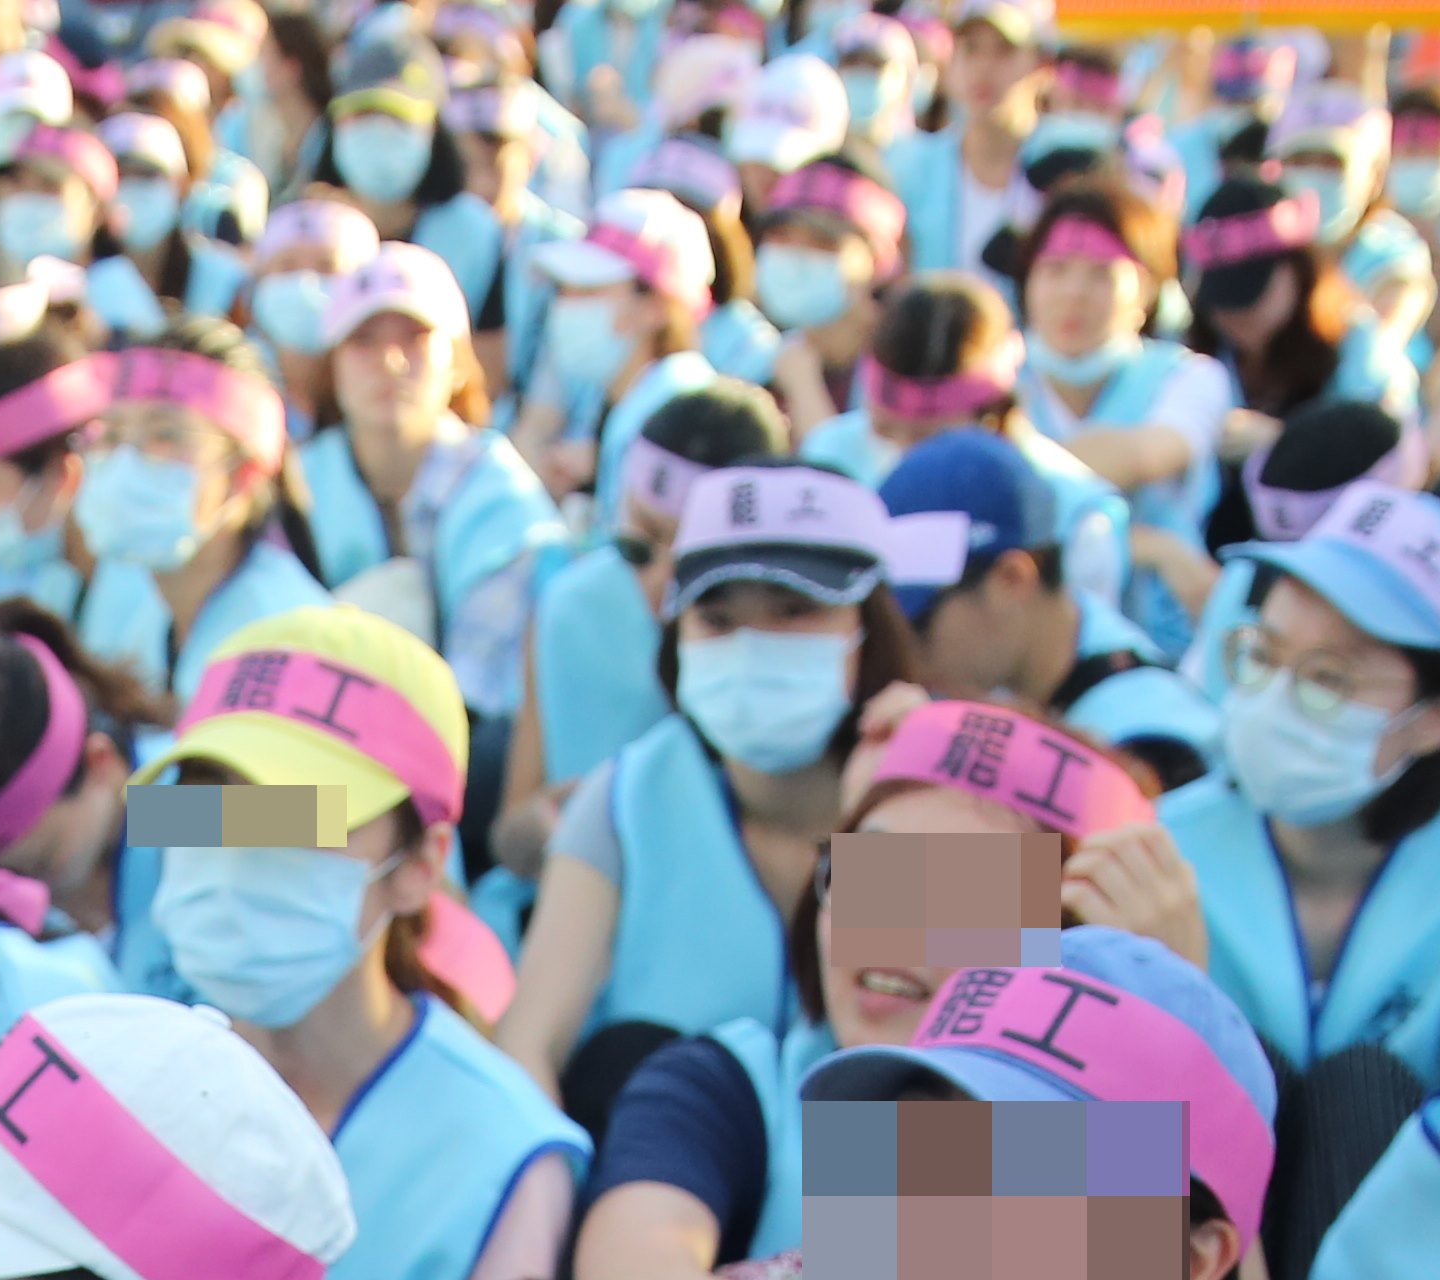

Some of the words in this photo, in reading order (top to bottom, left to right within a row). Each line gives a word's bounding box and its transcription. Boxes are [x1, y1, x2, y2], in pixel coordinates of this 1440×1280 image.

[215, 650, 376, 741] 罷工
[934, 710, 1091, 824] 罷工
[924, 967, 1118, 1070] 罷工
